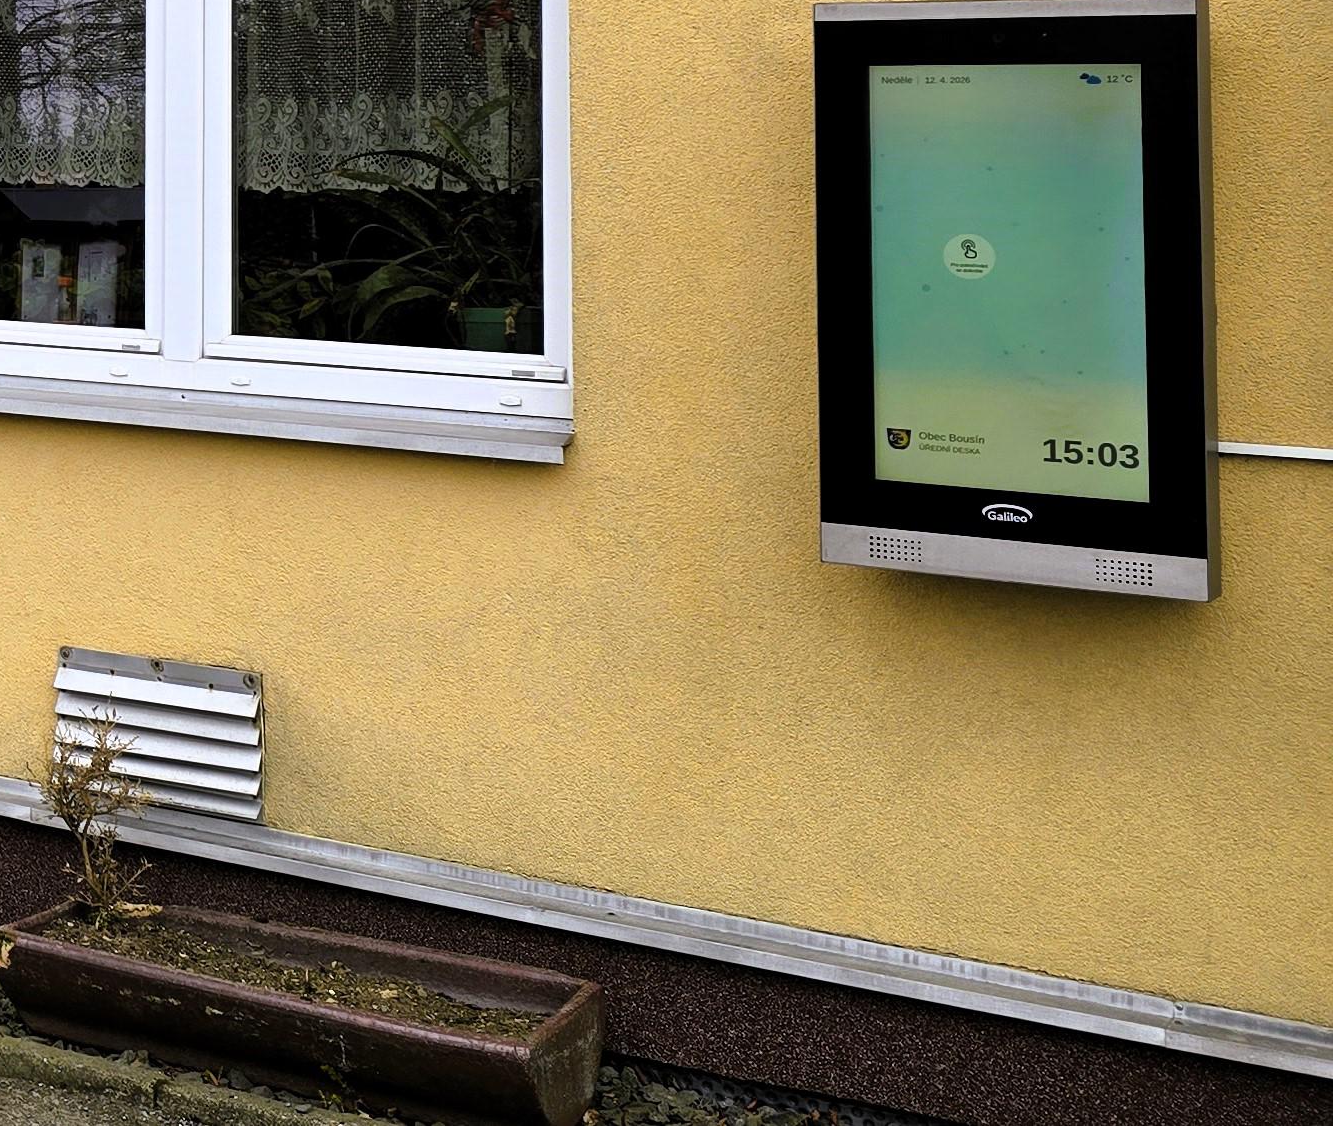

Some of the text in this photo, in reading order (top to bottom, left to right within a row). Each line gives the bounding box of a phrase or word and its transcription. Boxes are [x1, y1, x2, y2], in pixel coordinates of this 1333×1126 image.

[918, 431, 986, 445] Obec Bousín
[952, 446, 981, 455] DESKA
[1042, 438, 1141, 469] 15:03
[987, 510, 1029, 523] Galileo
